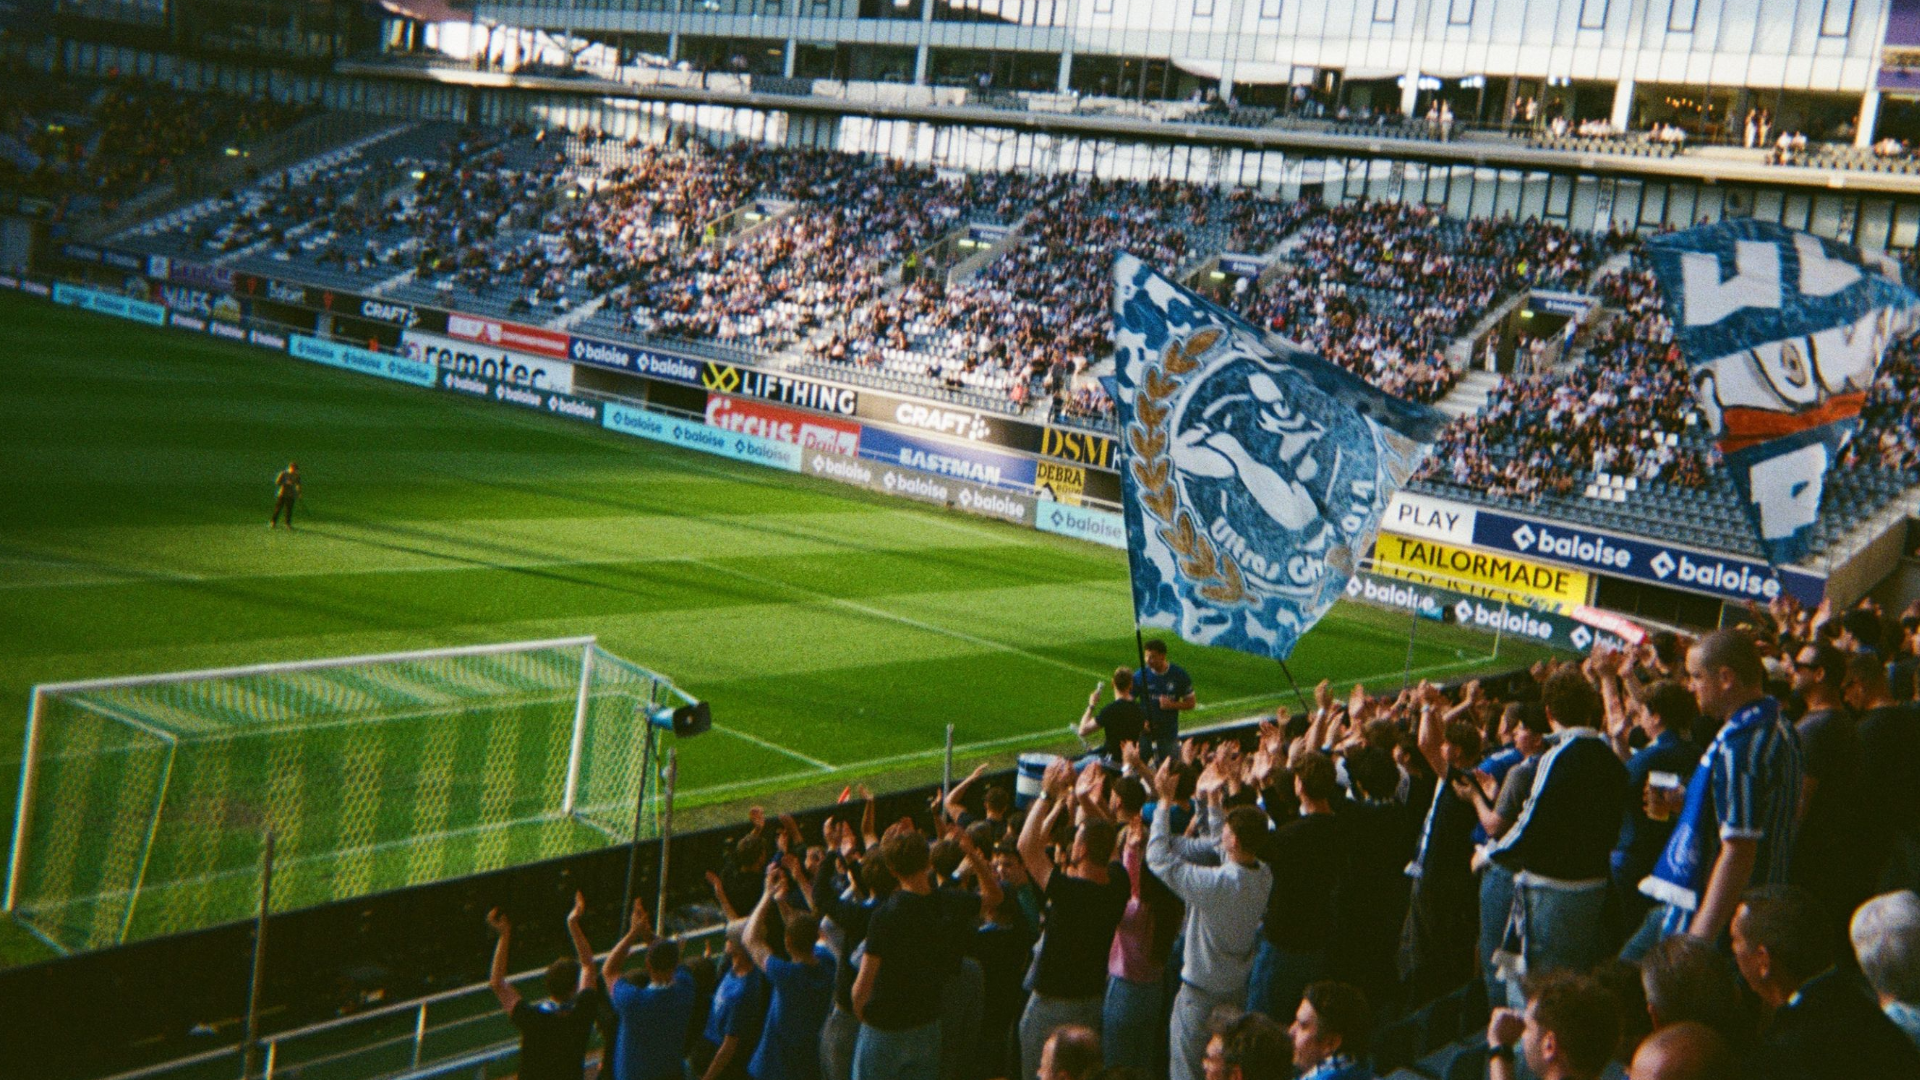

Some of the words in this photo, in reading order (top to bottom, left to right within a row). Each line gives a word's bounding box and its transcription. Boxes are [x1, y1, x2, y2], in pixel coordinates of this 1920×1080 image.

[362, 300, 410, 324] CRAFT
[585, 342, 629, 367] baloise
[650, 355, 697, 380] baloise
[741, 371, 856, 415] LIFTHING
[895, 402, 972, 436] CRAFT
[624, 415, 662, 434] baloise
[684, 430, 725, 449] baloise
[747, 445, 791, 464] baloise
[1040, 426, 1110, 468] DSM
[899, 447, 1001, 485] EASTMAN
[1036, 462, 1083, 487] DEBRA
[825, 456, 872, 484] baloise
[897, 472, 948, 501] baloise
[973, 489, 1025, 518] baloise
[1065, 512, 1123, 539] baloise
[1398, 503, 1460, 532] PLAY
[1210, 514, 1281, 581] Ultras
[1396, 537, 1571, 595] TAILORMADE
[1537, 528, 1632, 569] baloise
[1677, 555, 1782, 598] baloise
[1475, 602, 1553, 640] baloise
